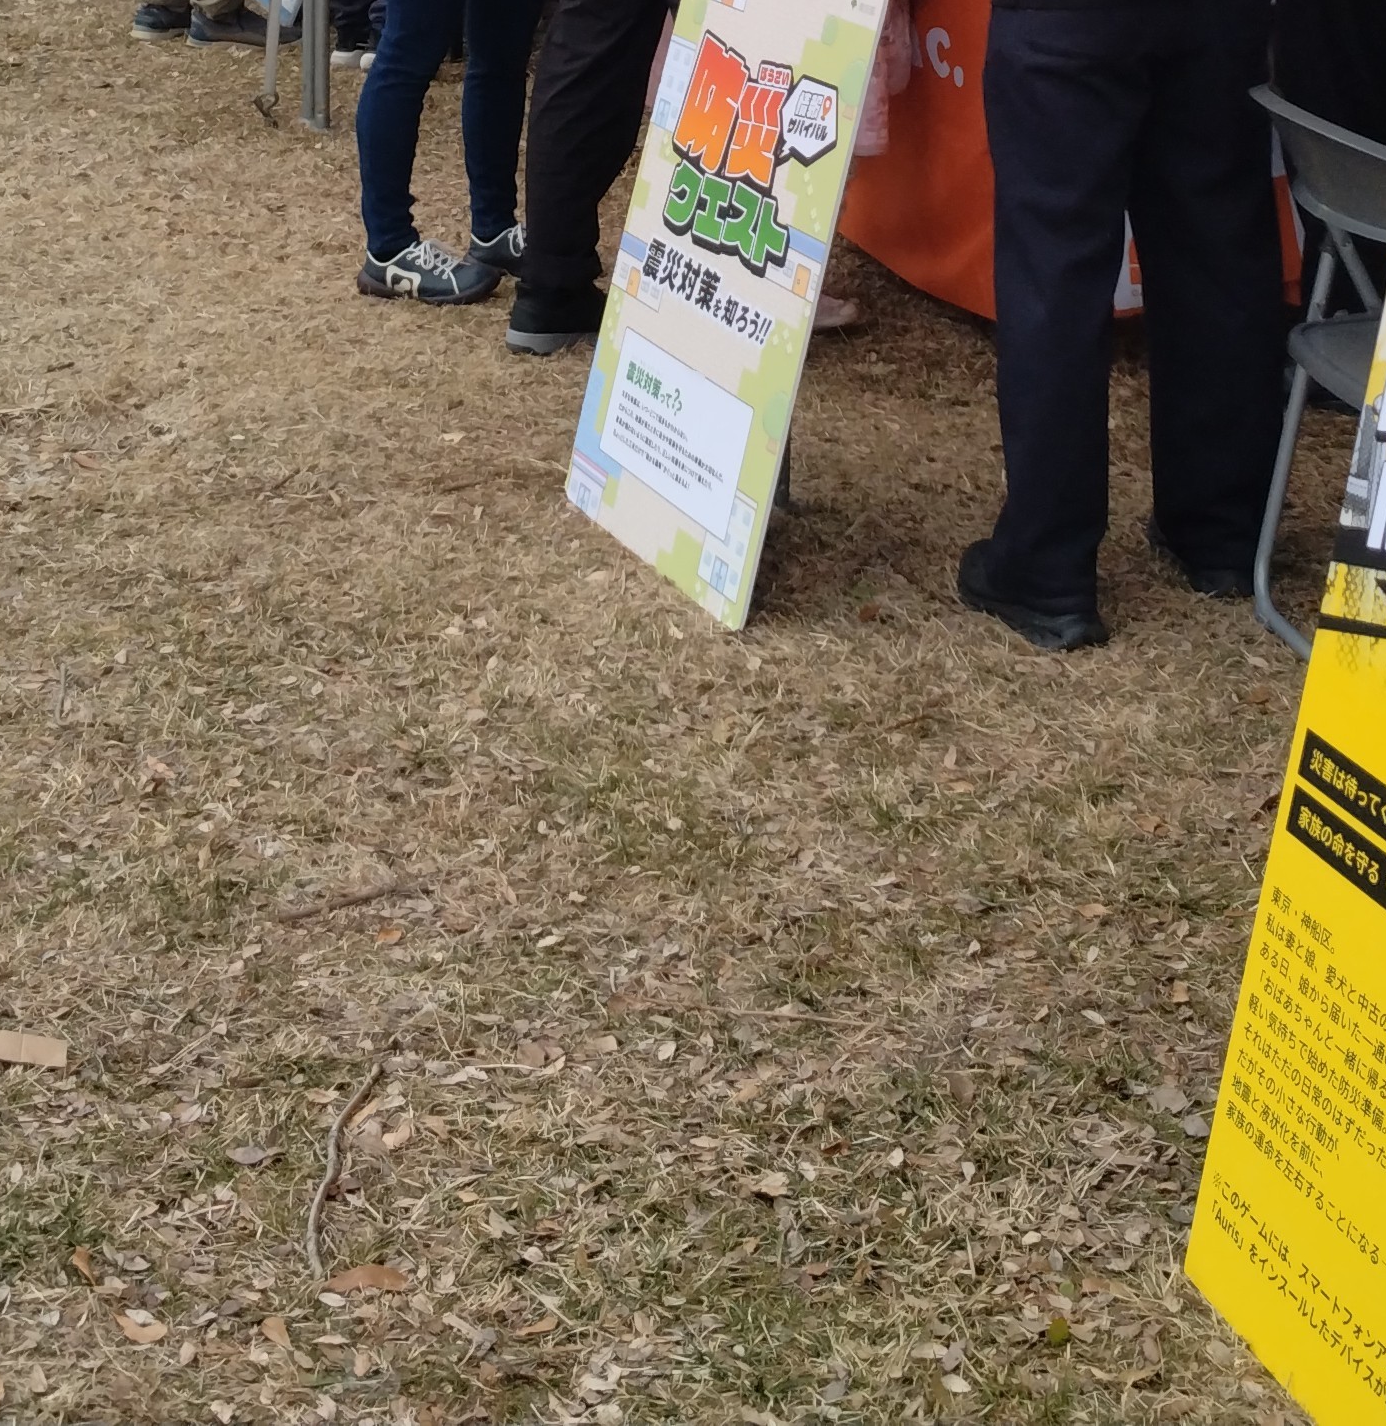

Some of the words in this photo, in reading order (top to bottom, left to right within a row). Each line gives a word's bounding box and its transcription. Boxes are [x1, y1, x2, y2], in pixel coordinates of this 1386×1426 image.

[674, 34, 789, 188] 防災
[786, 117, 829, 142] サバイバル
[663, 160, 789, 267] クエスト
[1270, 885, 1335, 954] 東京・神船区。
[1237, 1048, 1341, 1162] だがその小さな行動が、
[1248, 992, 1386, 1134] 軽い気持ちで始めた防災準備。
[1231, 1072, 1324, 1179] 地震と液状化を前に、
